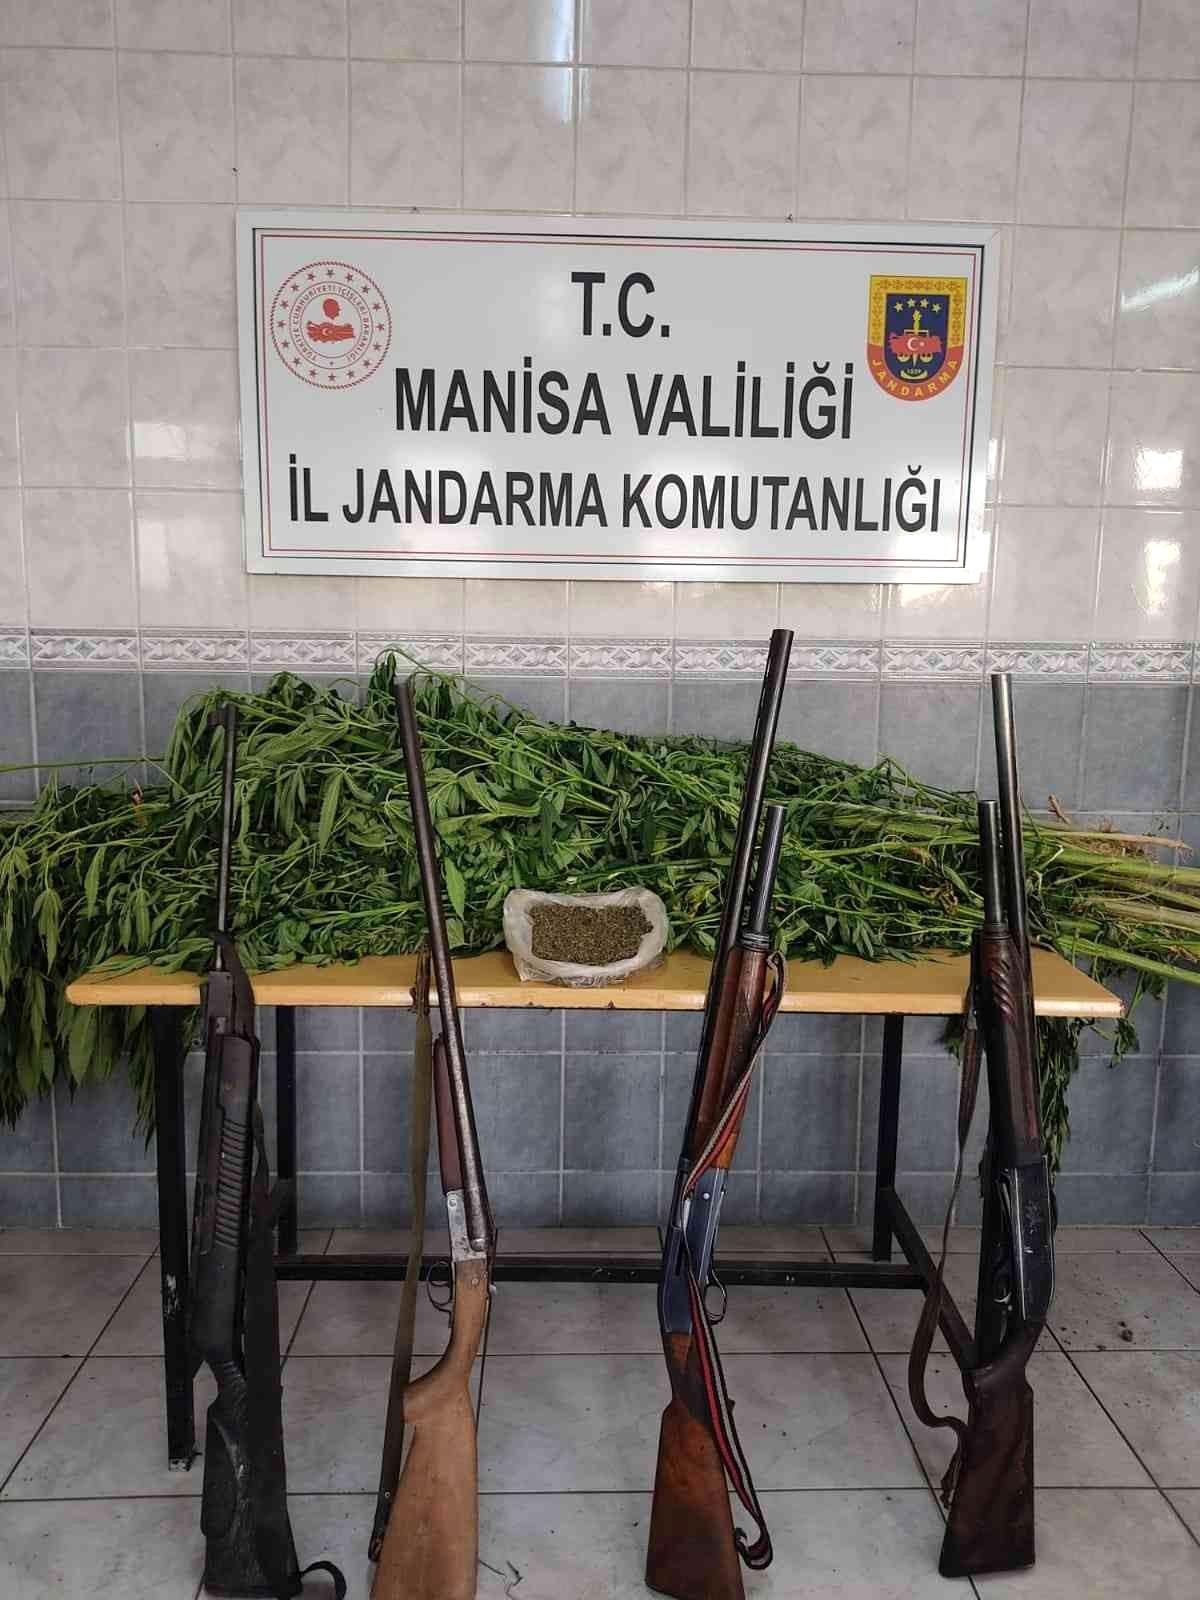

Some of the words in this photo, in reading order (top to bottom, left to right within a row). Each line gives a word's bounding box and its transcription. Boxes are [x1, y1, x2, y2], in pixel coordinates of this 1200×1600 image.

[571, 270, 670, 338] T.C.
[395, 356, 612, 436] MANİSA
[626, 361, 853, 440] VALİLİĞİ
[872, 360, 958, 397] JANDARMA
[289, 453, 329, 522] İL
[342, 468, 609, 529] JANDARMA
[622, 465, 942, 533] KOMUTANLIĞI
